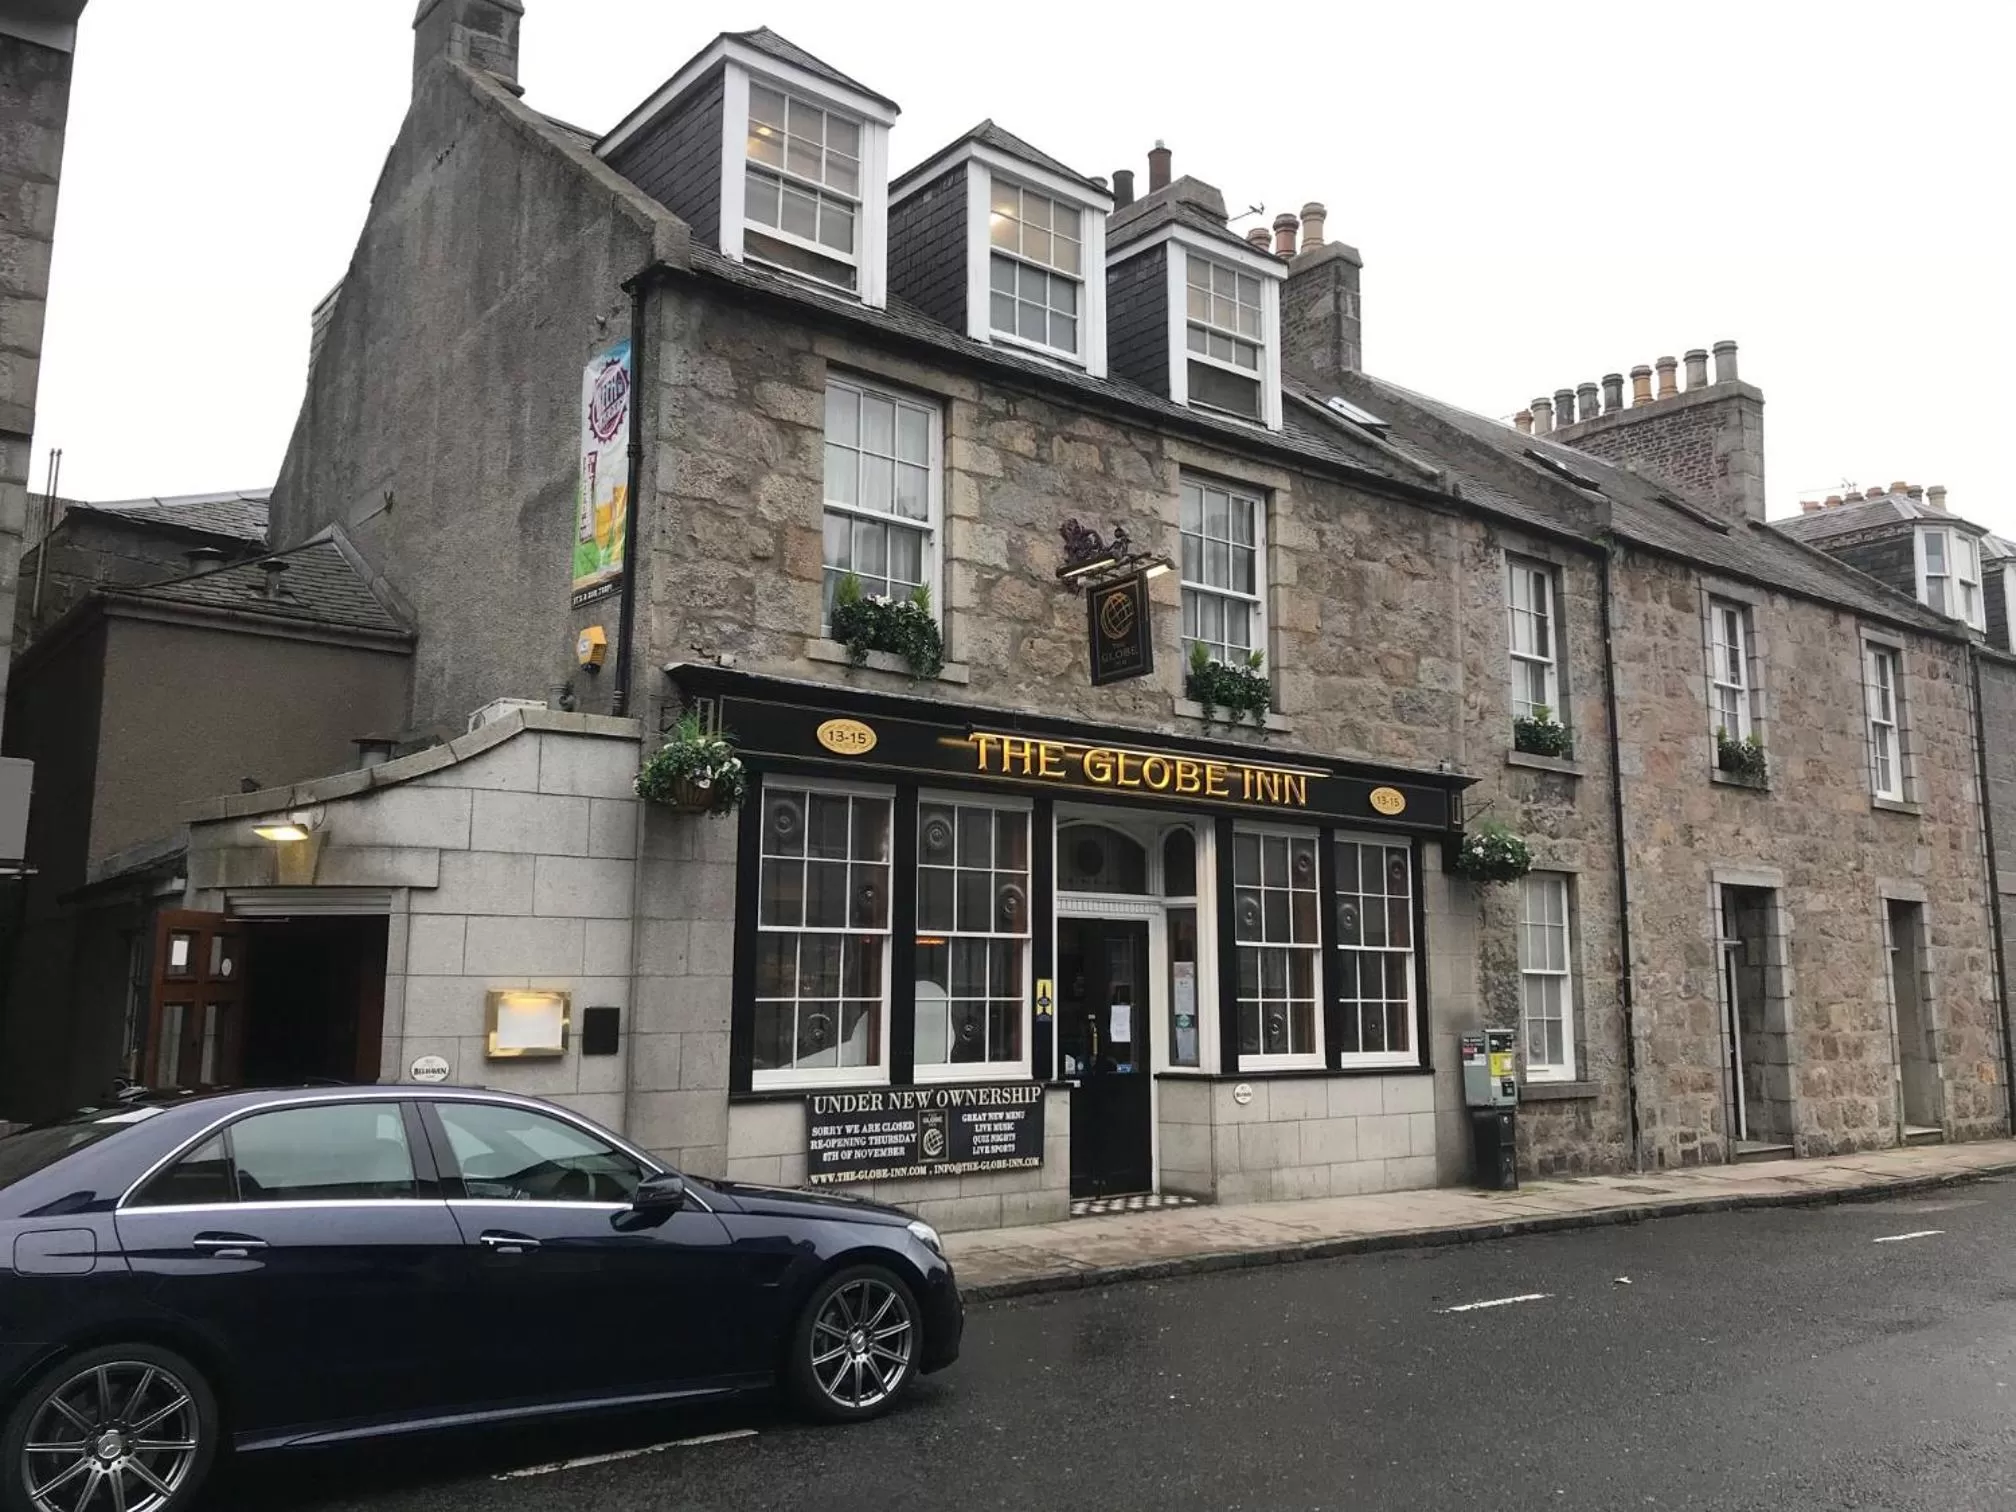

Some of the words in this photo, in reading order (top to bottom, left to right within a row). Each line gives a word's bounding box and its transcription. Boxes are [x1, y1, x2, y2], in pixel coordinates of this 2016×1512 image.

[827, 729, 866, 745] 13-15
[968, 732, 1066, 778] THE
[1082, 748, 1229, 796] GLOBE
[1242, 767, 1308, 805] INN
[1377, 794, 1401, 807] 13-15
[813, 1093, 886, 1115] UNDER
[888, 1089, 931, 1110] NEW
[936, 1086, 1041, 1108] OWNERSHIP
[961, 1112, 987, 1122] GREAT
[987, 1111, 1005, 1121] NEW
[1005, 1111, 1025, 1120] MENU
[811, 1125, 844, 1137] SORRY
[845, 1124, 861, 1134] WE
[861, 1123, 882, 1134] ARE
[881, 1121, 915, 1133] CLOSED
[974, 1123, 992, 1133] LIVE
[993, 1122, 1015, 1132] MUSIC
[810, 1136, 867, 1150] RE-OPENING
[868, 1133, 918, 1146] THURSDAY
[972, 1134, 990, 1145] QUIZ
[990, 1132, 1016, 1143] NIGHTS
[841, 1150, 854, 1160] OF
[854, 1147, 905, 1159] NOVEMBER
[972, 1146, 991, 1156] LIVE
[991, 1144, 1016, 1154] SPORTS
[810, 1166, 927, 1184] WWW.THE-GLOBE-INN.COM
[934, 1157, 1040, 1174] INFO@THE-GLOBE-INN.COM
